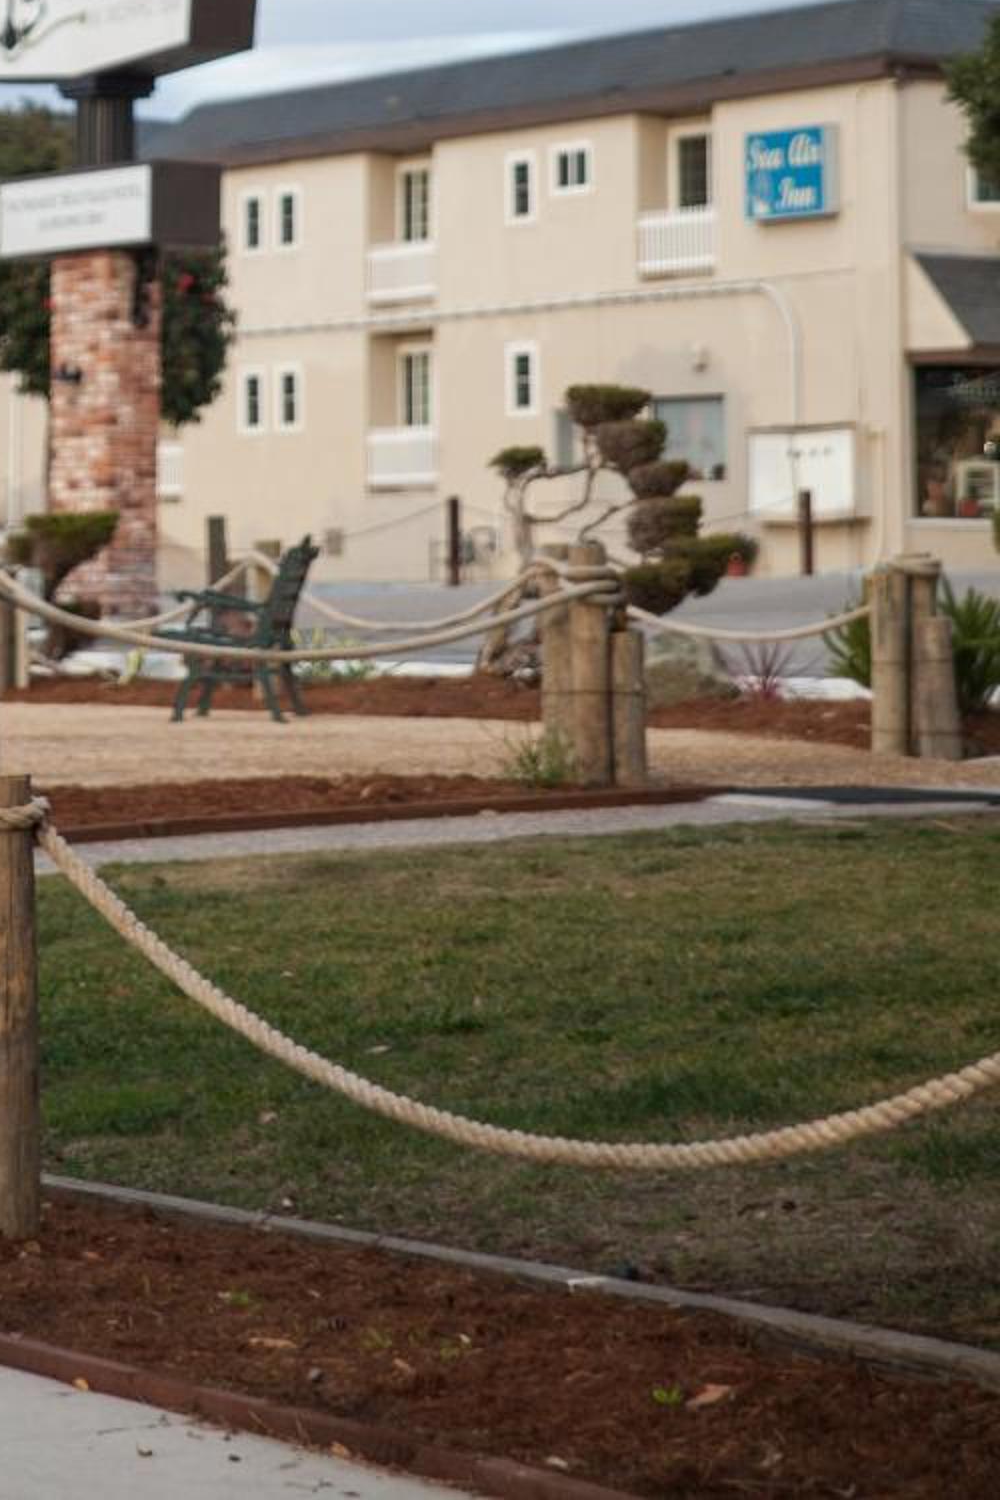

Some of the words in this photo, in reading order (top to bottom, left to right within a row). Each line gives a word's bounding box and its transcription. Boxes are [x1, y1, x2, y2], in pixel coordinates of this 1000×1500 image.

[747, 137, 782, 170] Sea
[787, 133, 821, 167] Air
[776, 177, 815, 210] Inn
